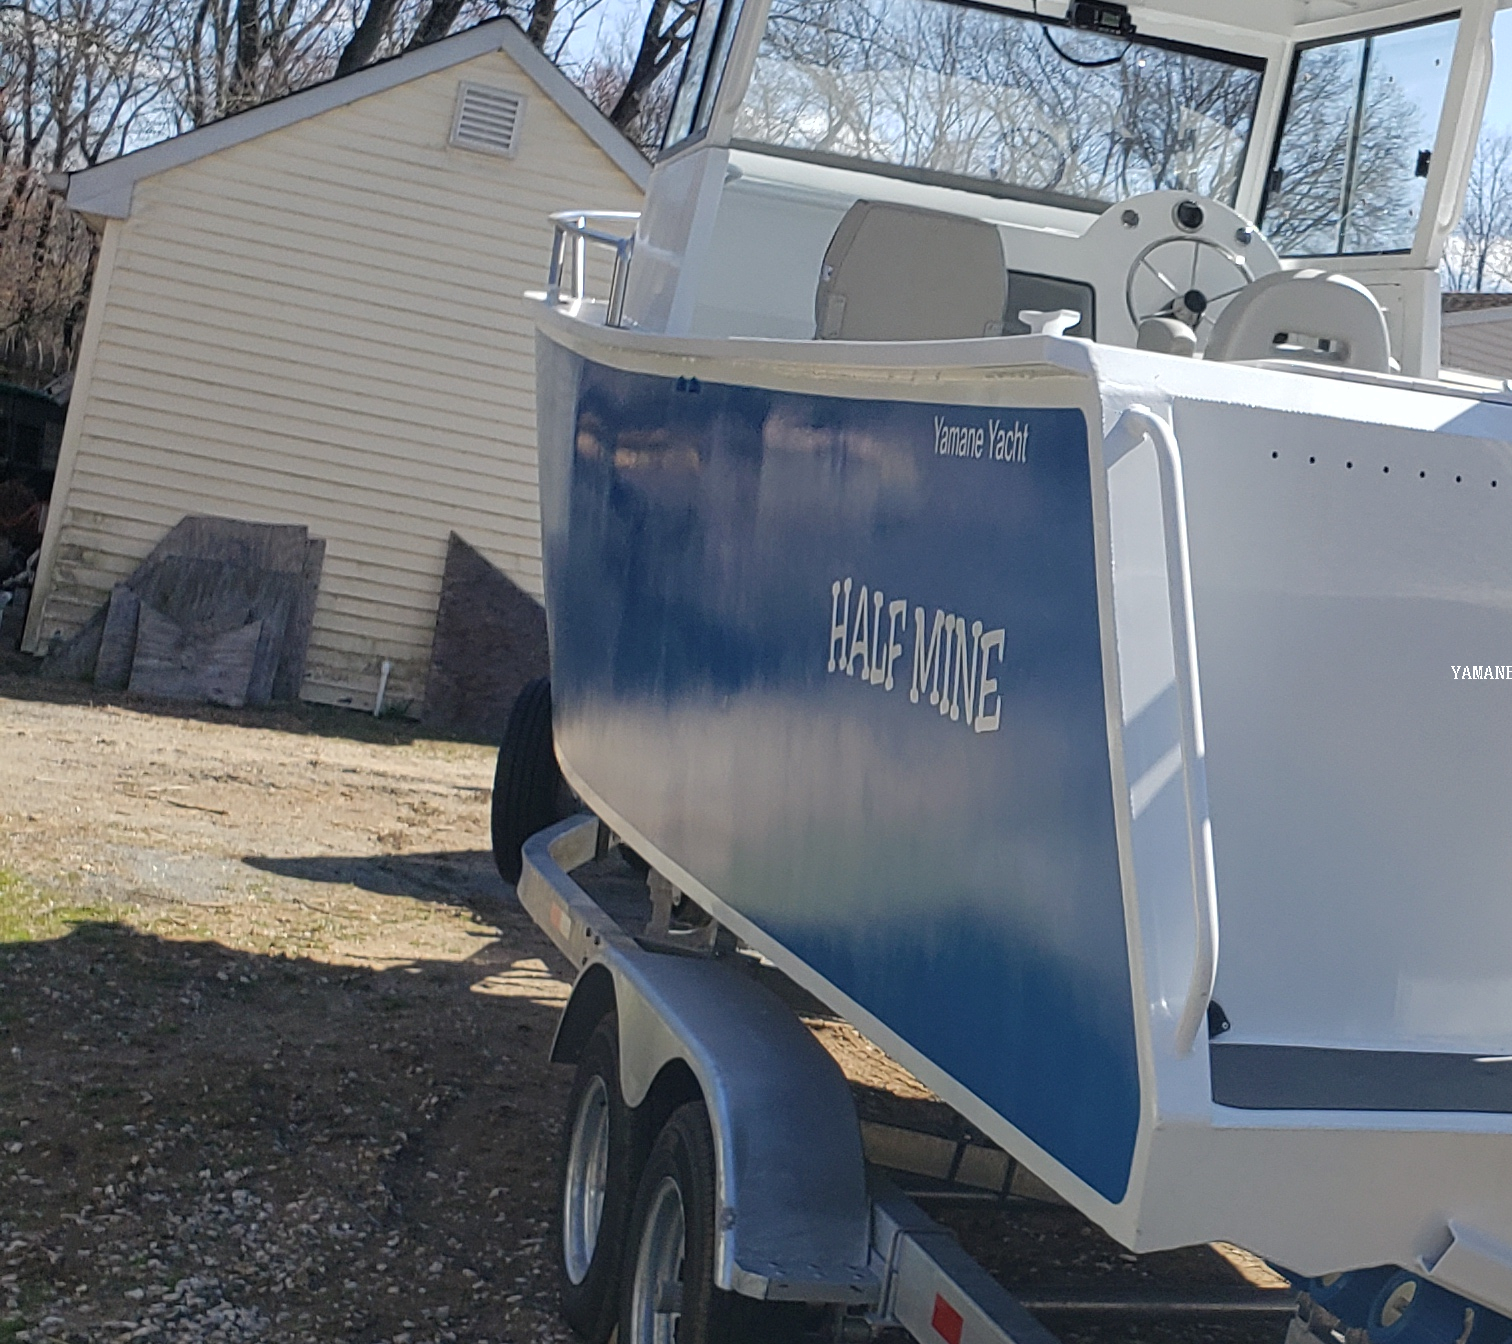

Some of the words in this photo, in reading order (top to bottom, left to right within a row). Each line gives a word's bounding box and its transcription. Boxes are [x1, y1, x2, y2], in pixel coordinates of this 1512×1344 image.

[934, 415, 984, 459] Yamane
[988, 418, 1029, 464] Yacht
[828, 577, 907, 691] HALF
[910, 607, 1005, 733] MINE
